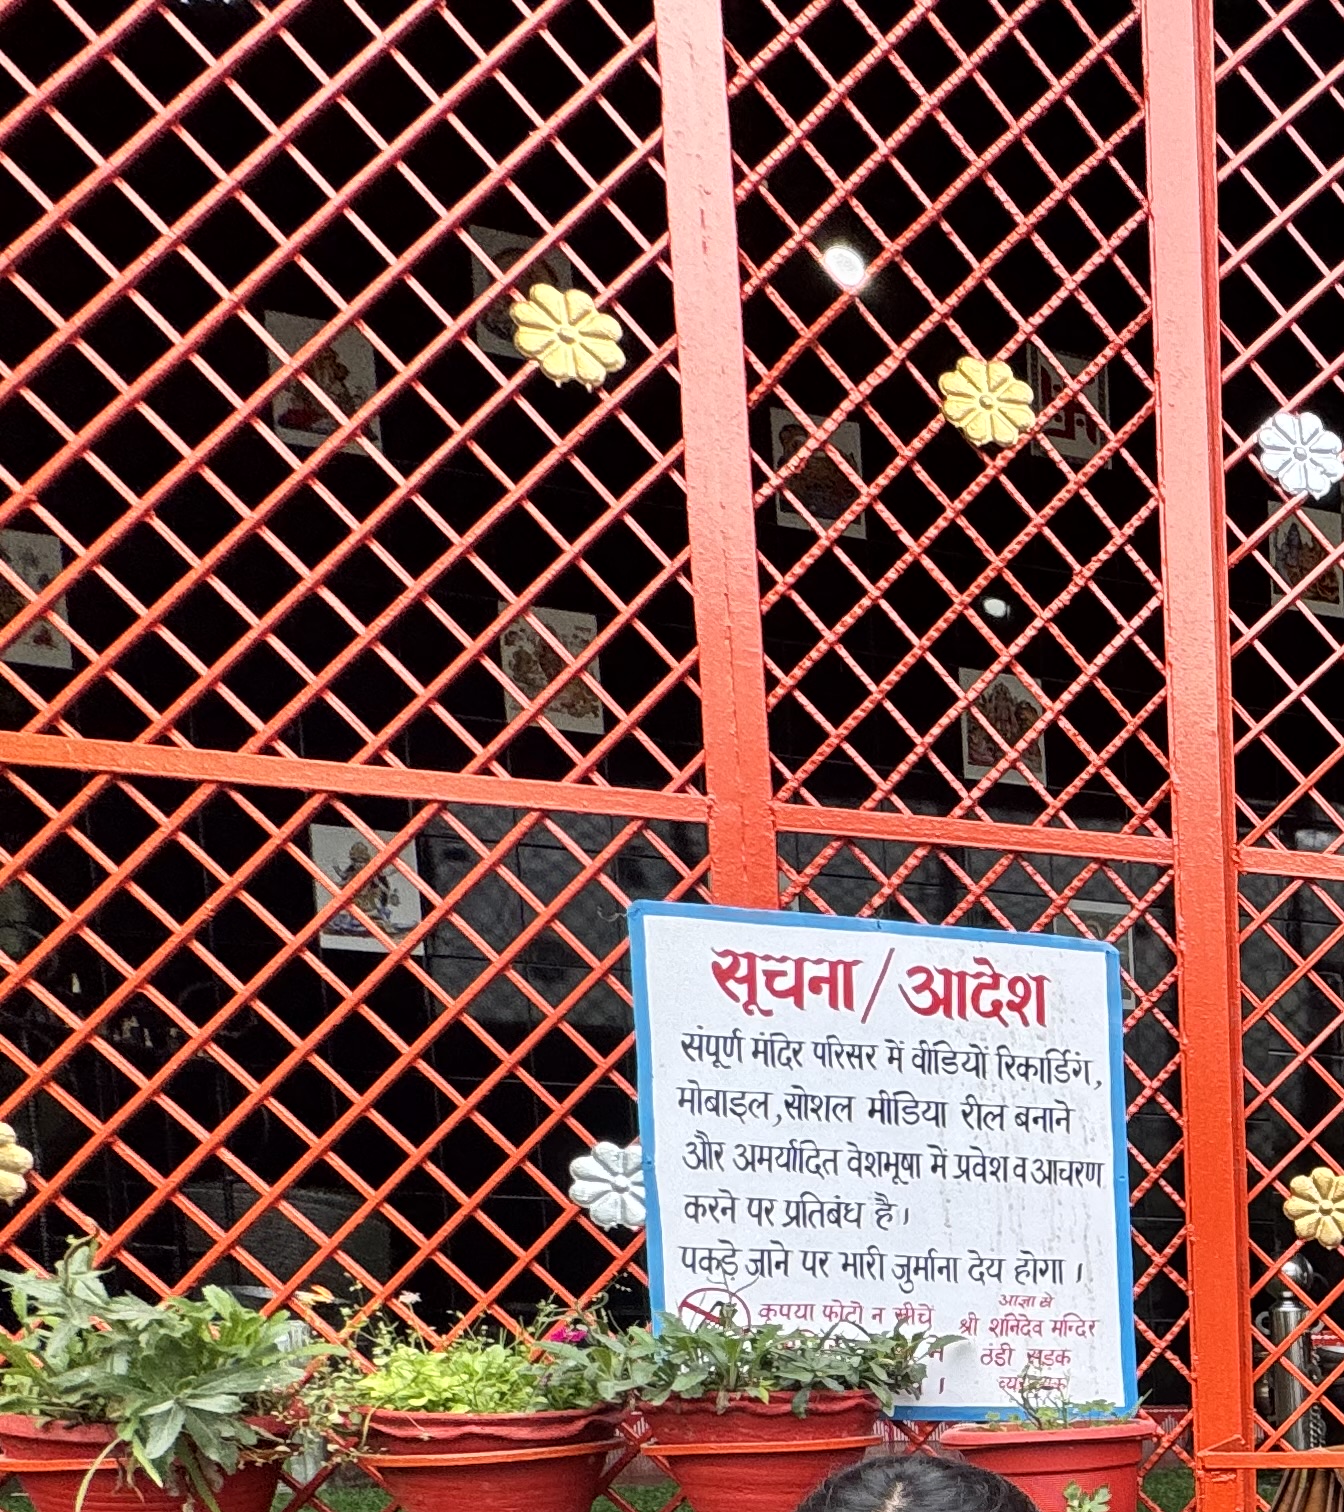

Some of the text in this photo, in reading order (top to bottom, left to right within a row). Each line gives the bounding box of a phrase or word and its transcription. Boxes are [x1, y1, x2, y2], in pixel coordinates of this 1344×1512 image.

[681, 1026, 745, 1070] संपूर्ण
[751, 1032, 805, 1066] मंदिर
[811, 1037, 878, 1072] परिसर
[887, 1041, 905, 1073] में
[867, 1090, 948, 1129] मीडिया
[961, 1100, 1005, 1133] रील
[1013, 1100, 1076, 1135] बनाने
[682, 1130, 1104, 1189] और अमर्यादित वेशभूषा में प्रवेश व आचरण
[683, 1188, 738, 1226] करने
[747, 1198, 775, 1226] पर
[781, 1195, 865, 1231] प्रतिबंध
[744, 1240, 792, 1279] जाने
[801, 1247, 831, 1280] पर
[841, 1244, 887, 1283] भारी
[895, 1247, 959, 1293] जुर्माना
[967, 1249, 1003, 1286] देय
[822, 1301, 867, 1324] फोटो
[872, 1306, 886, 1324] न
[959, 1303, 1100, 1337] श्री शनिदेव मन्दिर
[979, 1338, 1016, 1366] ठंडी
